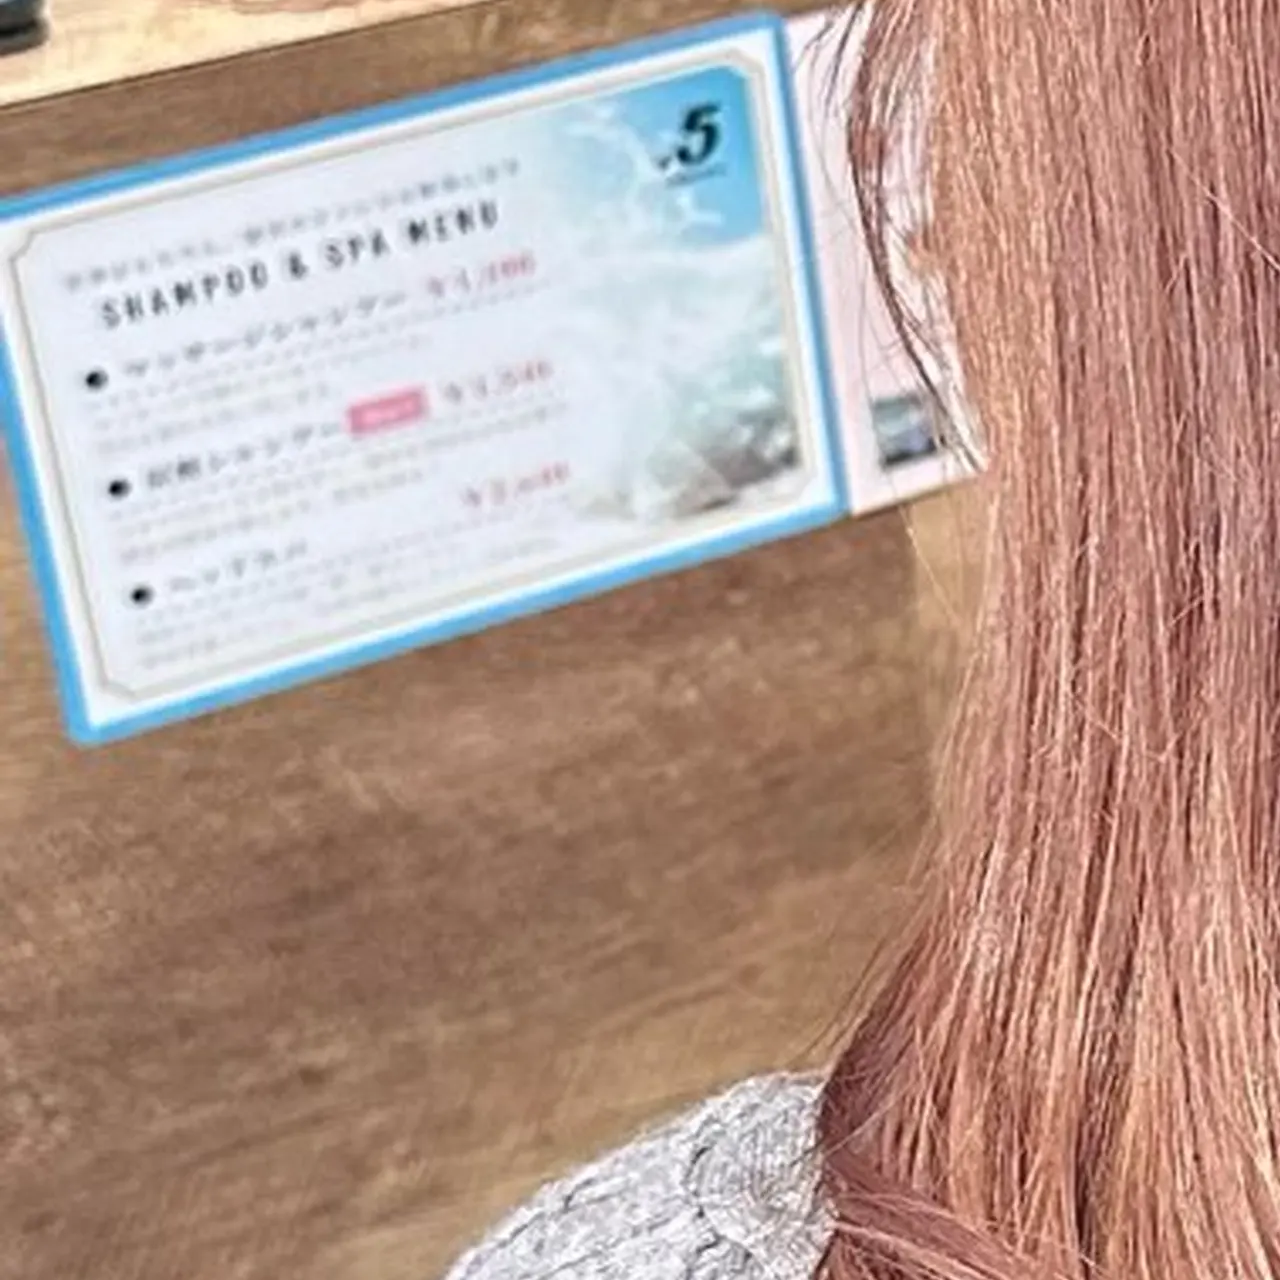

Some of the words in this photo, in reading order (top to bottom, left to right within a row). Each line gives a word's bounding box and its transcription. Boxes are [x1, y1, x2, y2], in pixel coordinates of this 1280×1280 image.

[101, 261, 268, 328] SHAMPOO
[323, 228, 390, 267] SPA
[406, 200, 499, 246] MENU
